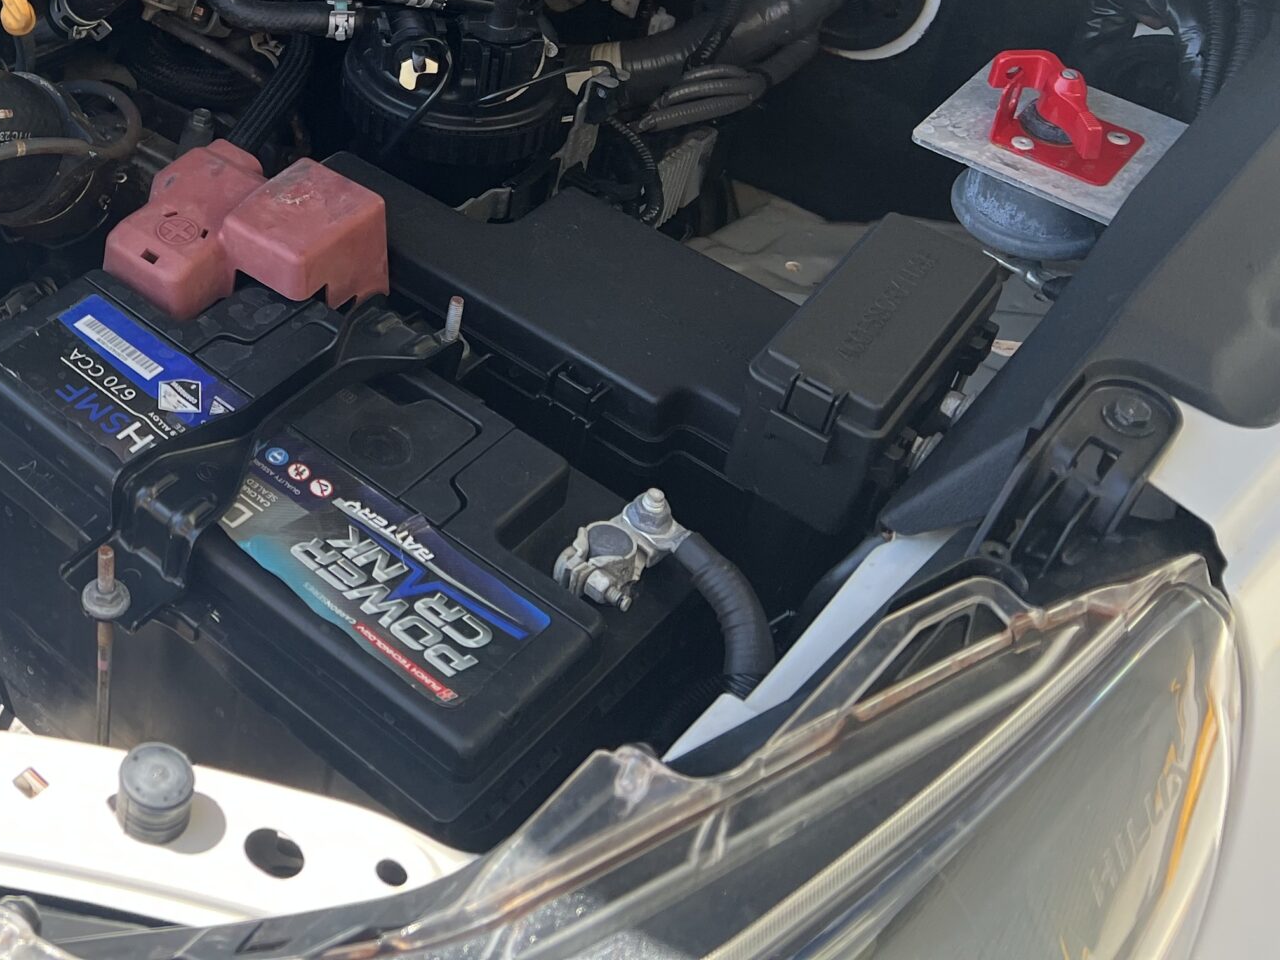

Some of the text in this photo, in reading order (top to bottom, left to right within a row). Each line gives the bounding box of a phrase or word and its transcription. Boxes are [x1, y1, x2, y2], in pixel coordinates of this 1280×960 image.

[69, 348, 106, 378] CCA
[102, 377, 137, 402] 670
[147, 411, 172, 433] ALLOY
[246, 477, 279, 503] SEALED
[274, 474, 301, 496] QUALITY
[343, 500, 436, 562] BATTERY
[290, 538, 480, 678] POWER
[356, 625, 413, 670] TECHNOLOGY
[411, 666, 442, 687] PUNCH
